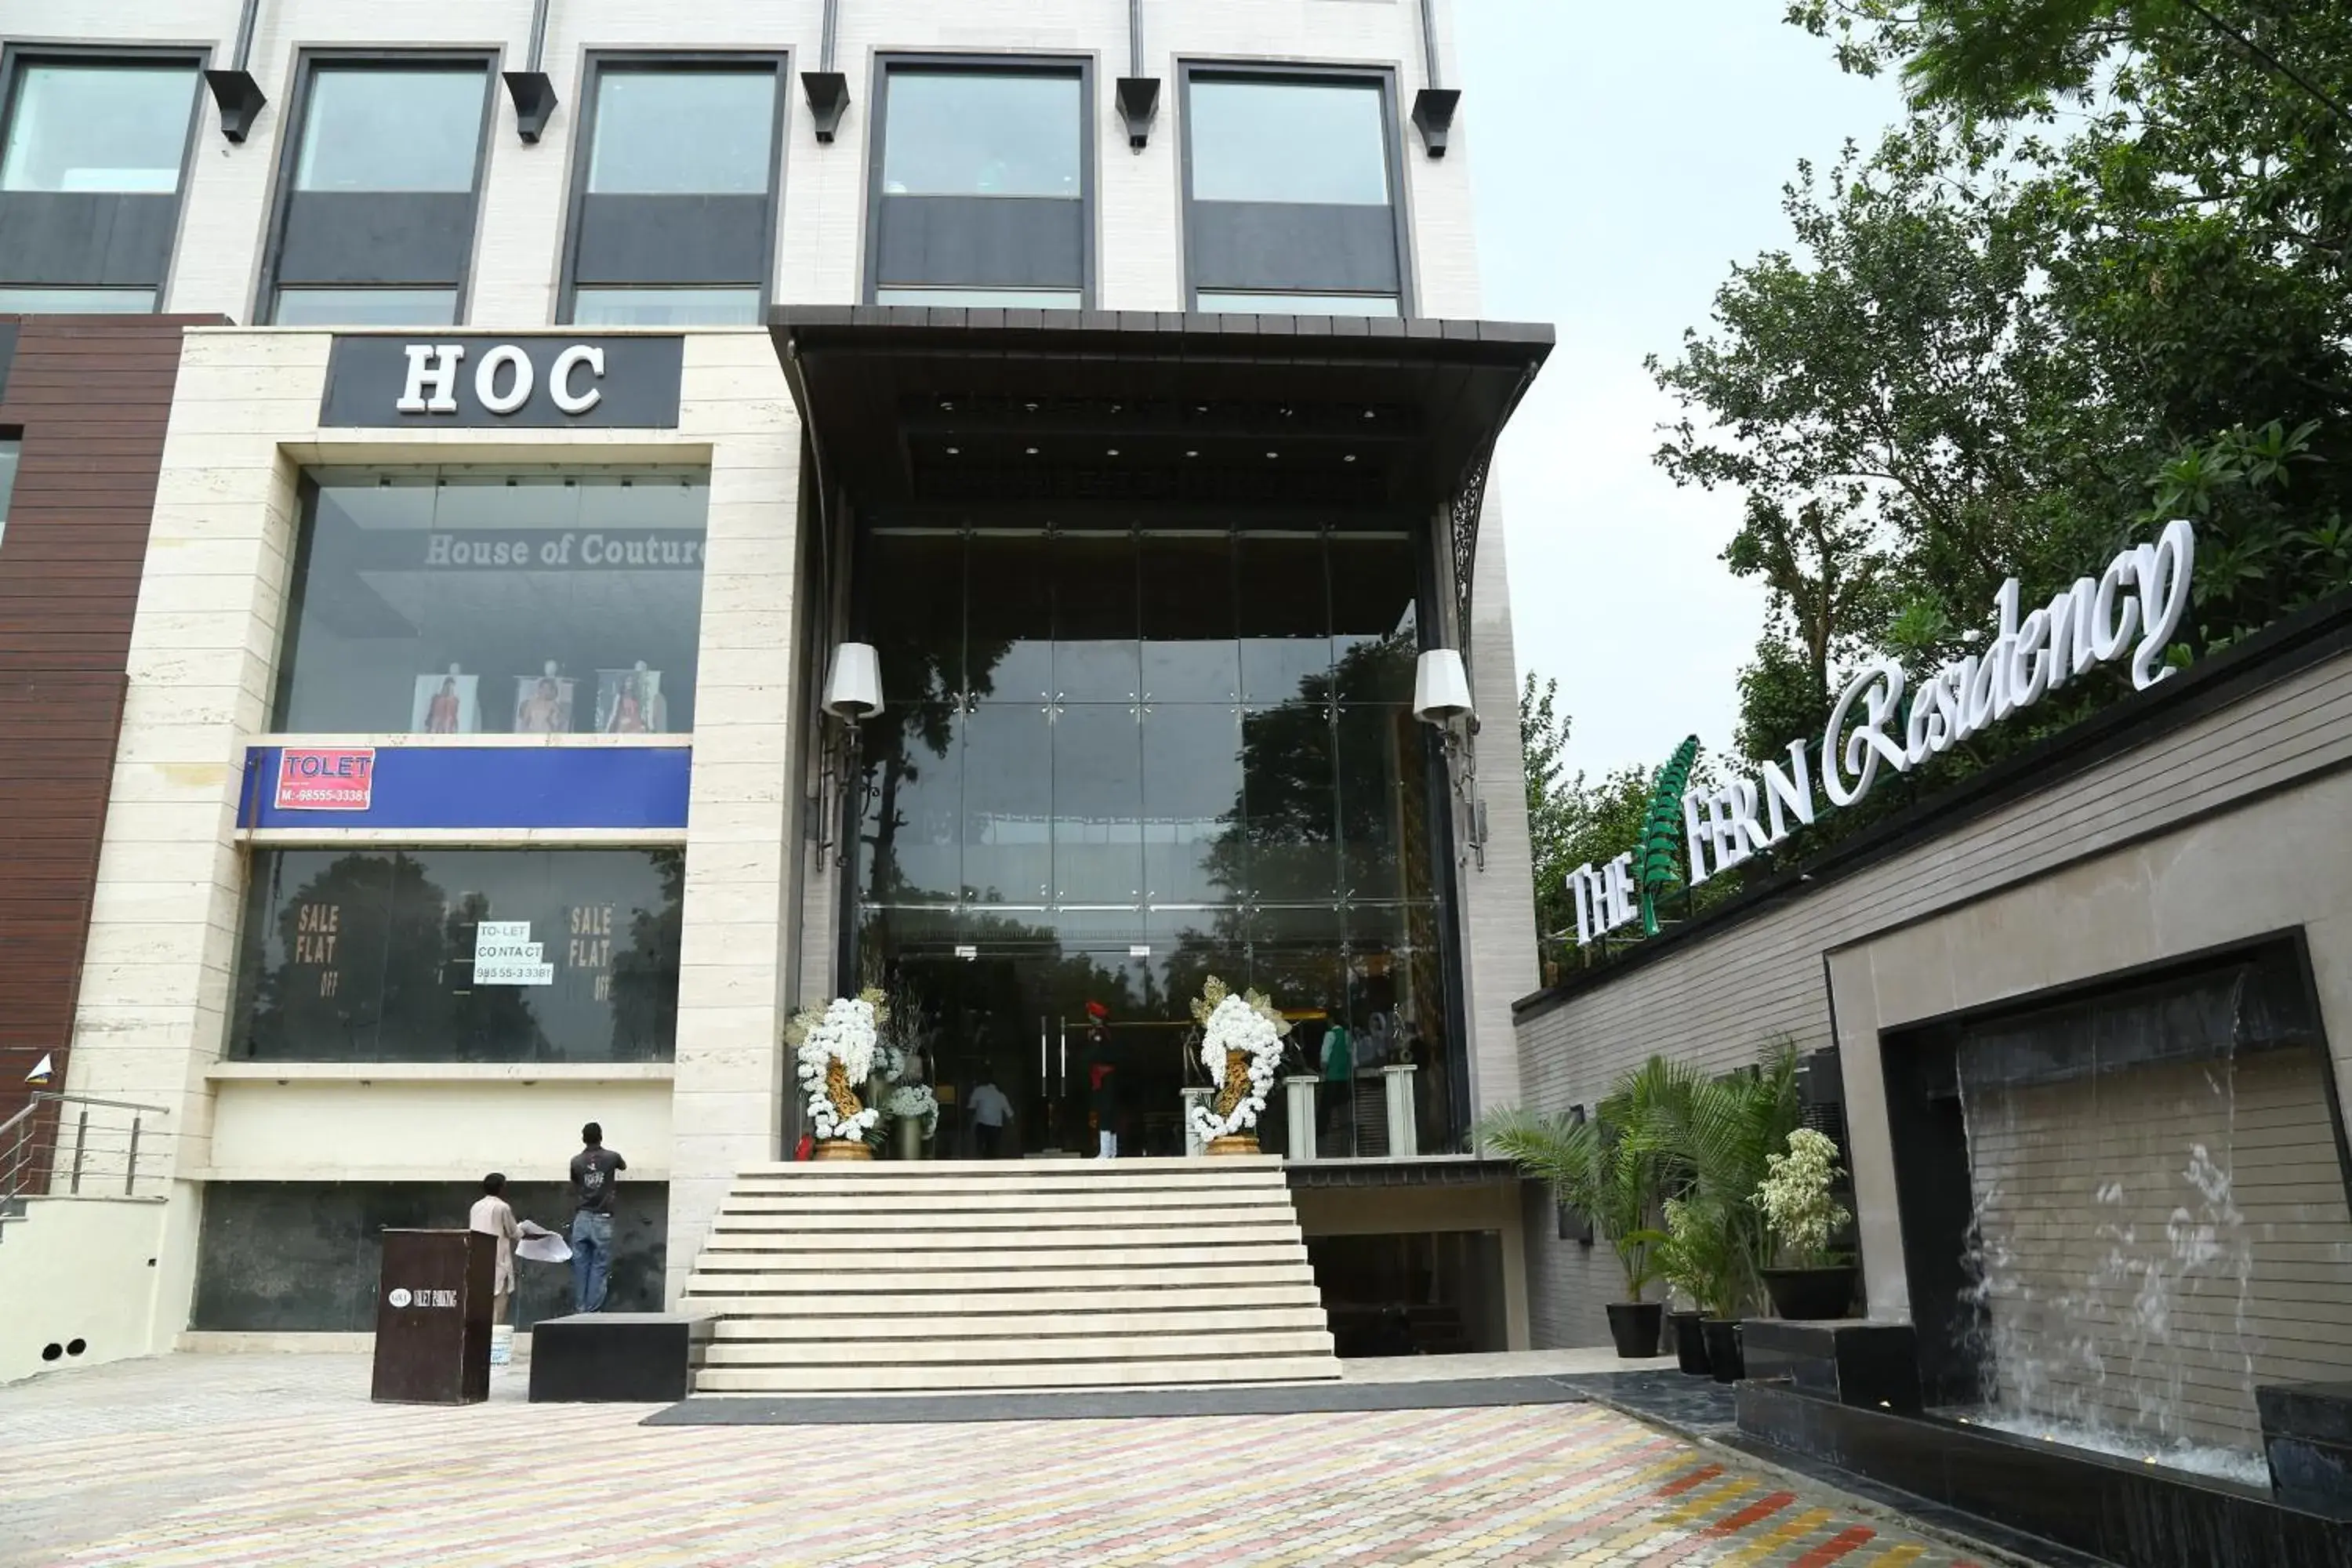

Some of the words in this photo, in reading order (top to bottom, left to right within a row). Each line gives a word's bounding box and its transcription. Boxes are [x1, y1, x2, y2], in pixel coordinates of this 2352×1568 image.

[397, 345, 604, 414] HOC
[424, 535, 528, 564] House
[540, 533, 575, 564] of
[1566, 851, 1639, 946] THE
[1682, 738, 1815, 887] FERN
[1821, 520, 2194, 807] Residency
[299, 904, 339, 932] SALE
[571, 907, 612, 935] SALE
[296, 936, 336, 964] FLAT
[477, 946, 543, 957] CONTACT
[569, 939, 610, 967] FLAT
